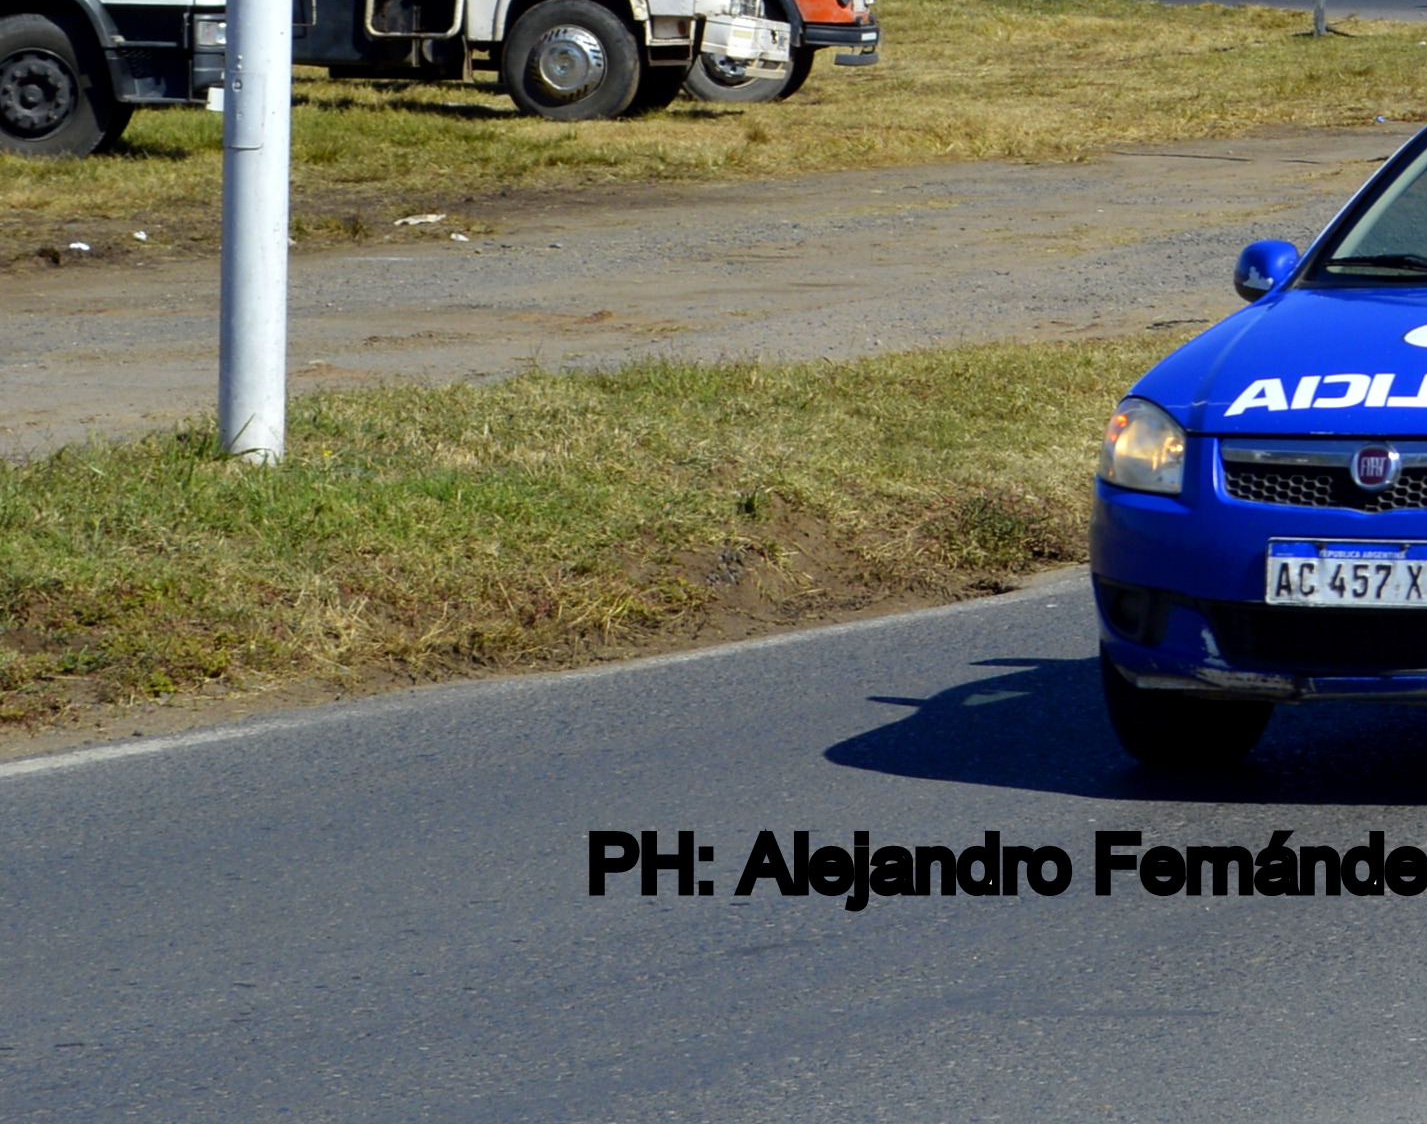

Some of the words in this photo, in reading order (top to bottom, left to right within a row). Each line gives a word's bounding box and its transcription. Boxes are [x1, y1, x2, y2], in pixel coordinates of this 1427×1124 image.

[1360, 456, 1387, 477] FIAT
[1275, 562, 1315, 597] AC
[1330, 563, 1392, 599] 457
